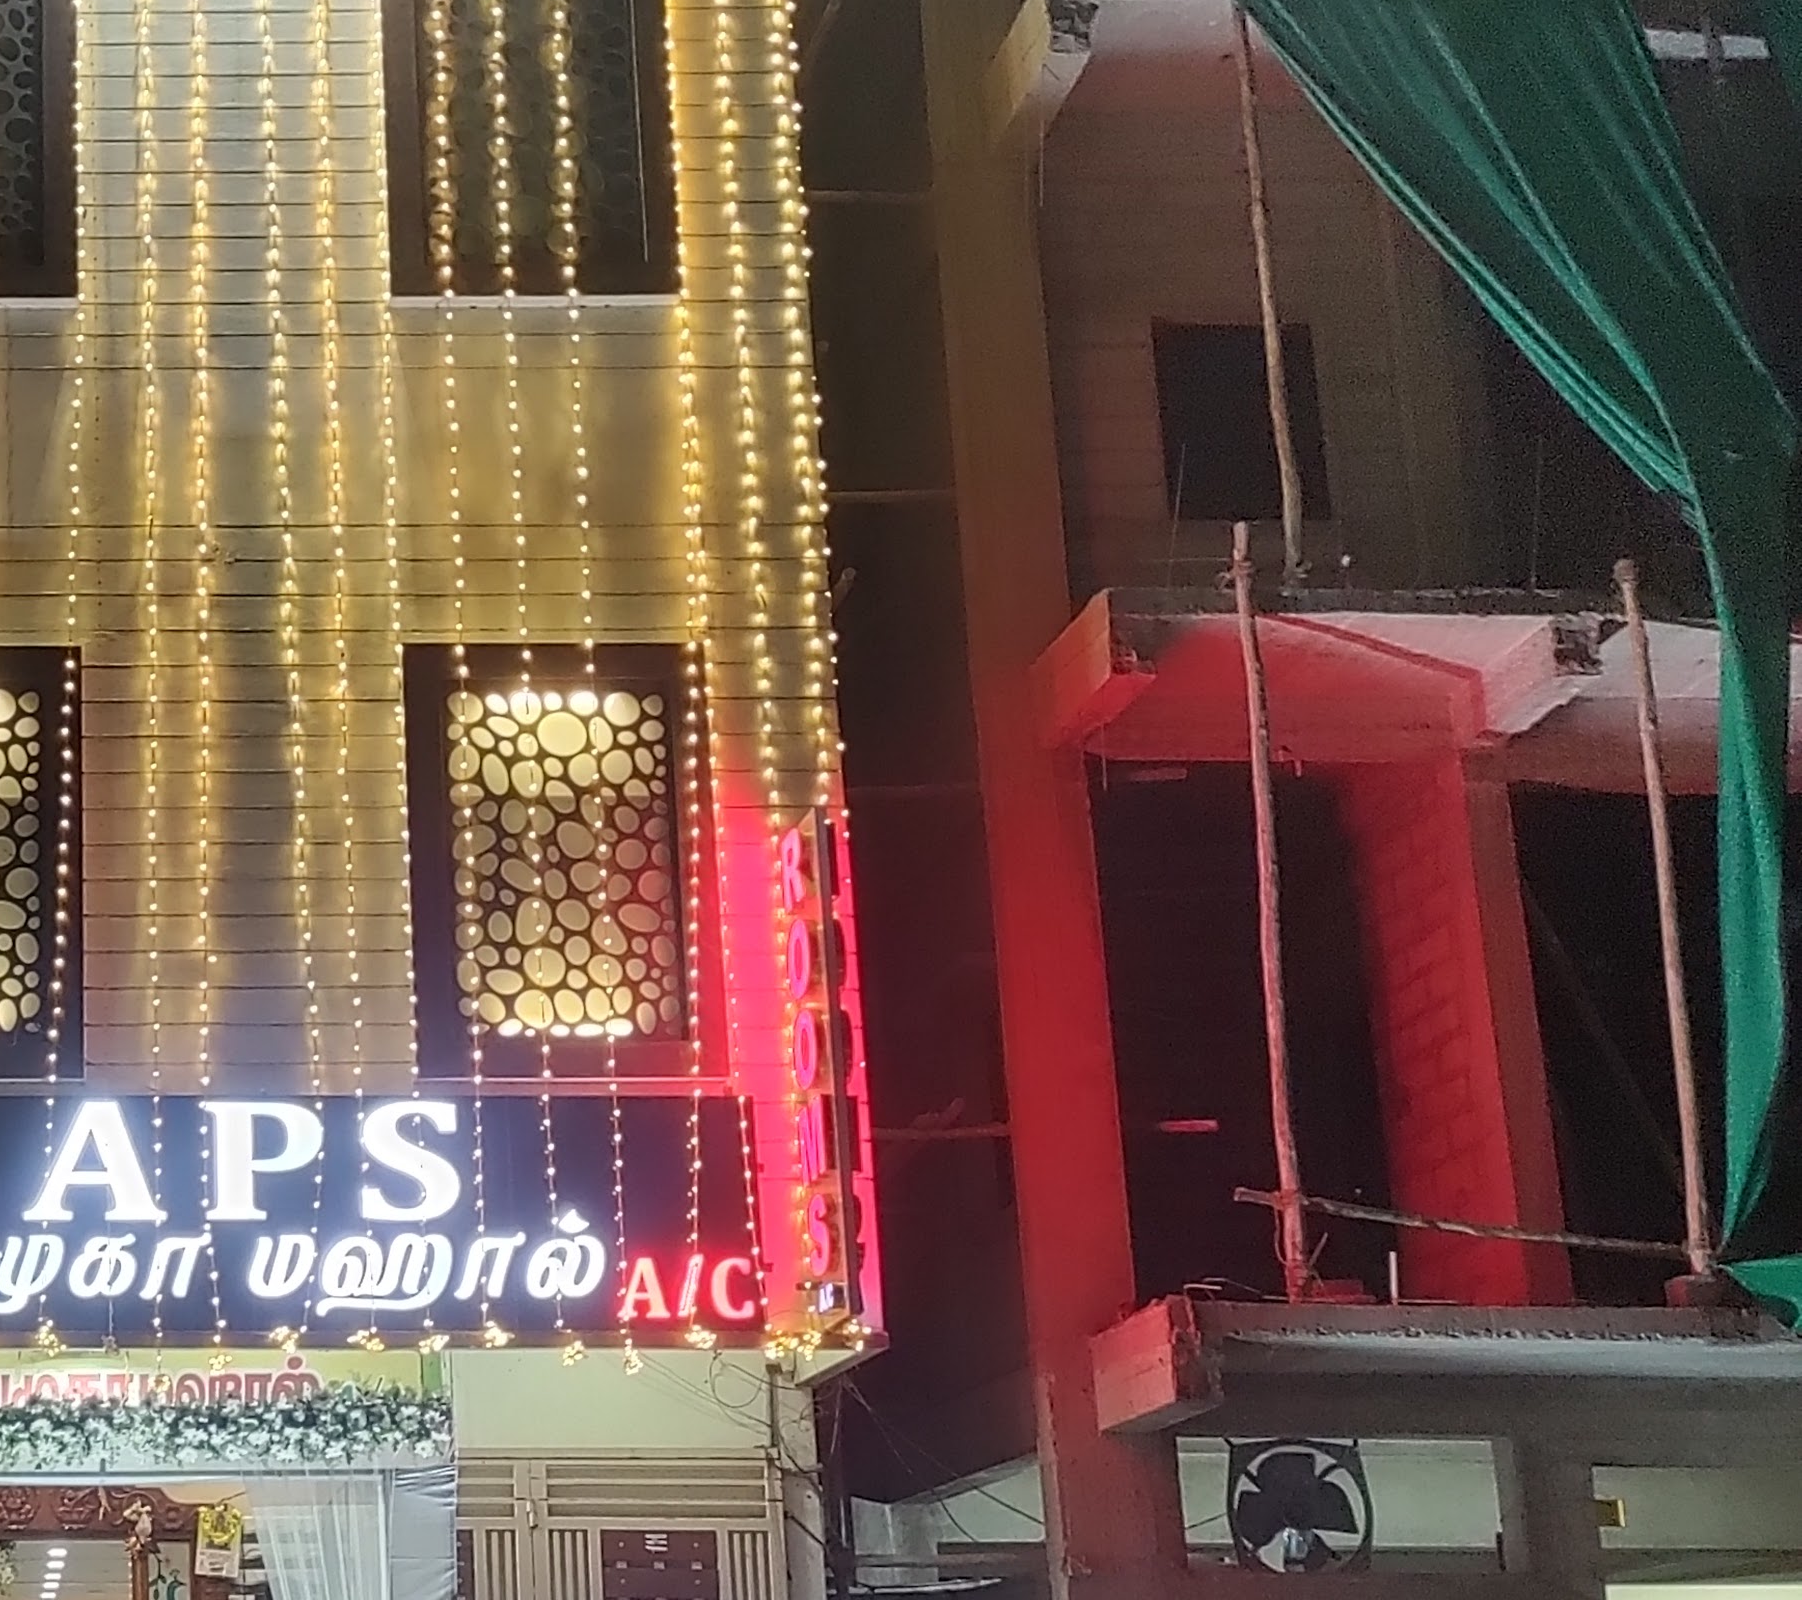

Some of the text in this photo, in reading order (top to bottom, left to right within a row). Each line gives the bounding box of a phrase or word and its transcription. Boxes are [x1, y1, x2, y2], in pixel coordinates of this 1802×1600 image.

[781, 827, 832, 1277] ROOMS
[21, 1098, 462, 1223] APS
[246, 1208, 607, 1318] மஹால்
[616, 1253, 756, 1321] A/C
